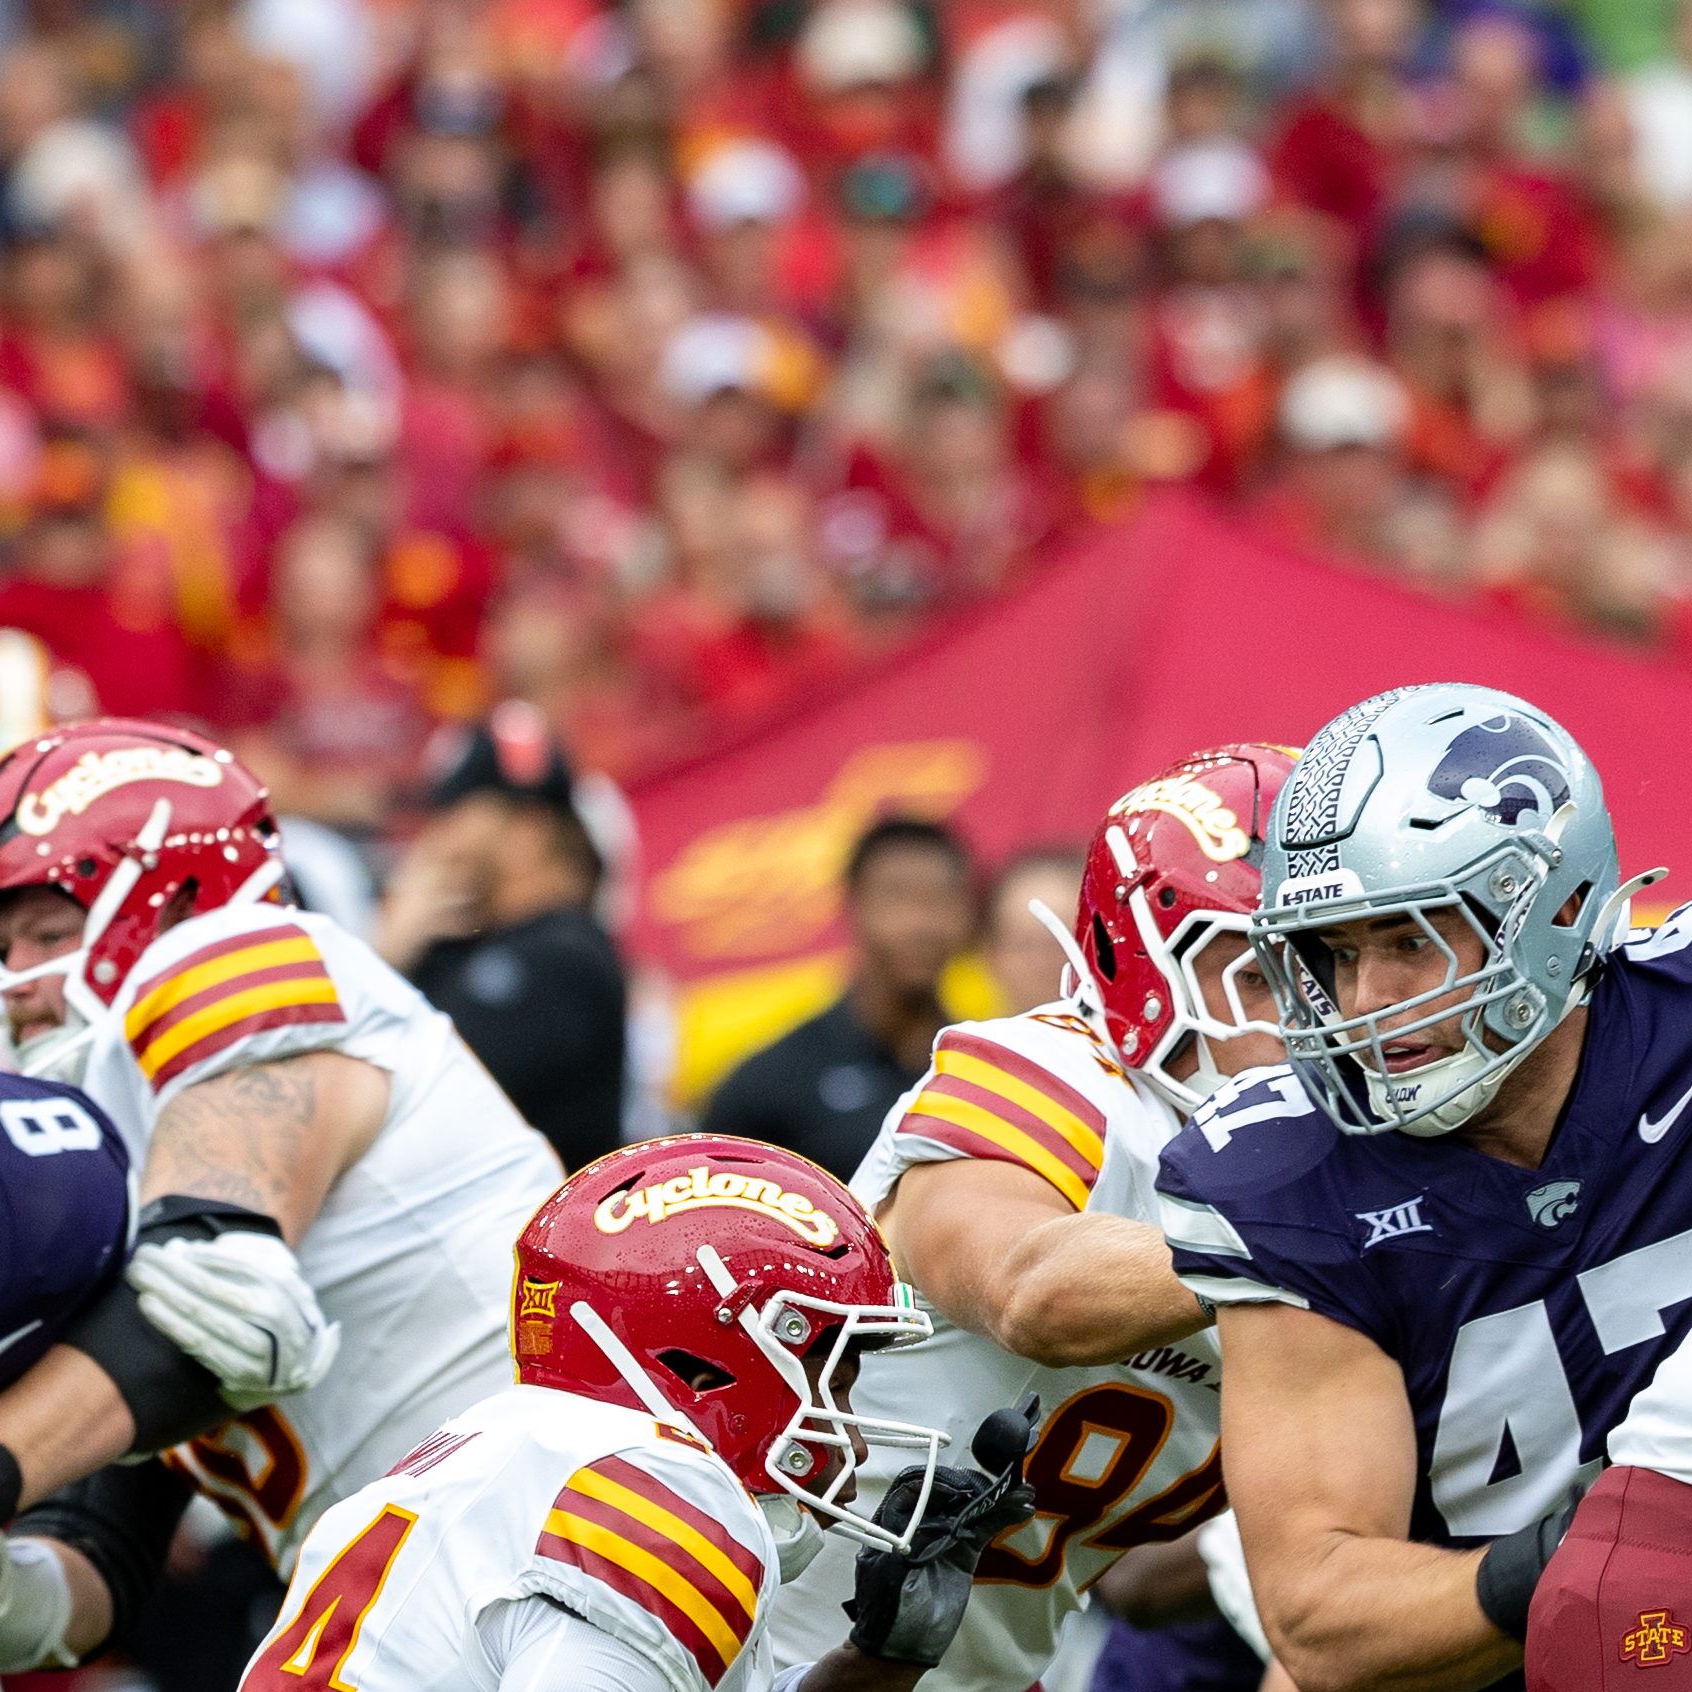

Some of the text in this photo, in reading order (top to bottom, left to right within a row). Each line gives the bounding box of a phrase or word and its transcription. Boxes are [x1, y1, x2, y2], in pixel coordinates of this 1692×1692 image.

[16, 747, 223, 836] Cyclones
[1108, 773, 1249, 862] Cyclones
[1282, 883, 1344, 907] K-STATE
[1192, 1063, 1317, 1153] 47
[594, 1166, 840, 1248] Cyclones
[1356, 1194, 1434, 1249] XII
[971, 1381, 1231, 1595] 94
[1624, 1627, 1684, 1653] STATE
